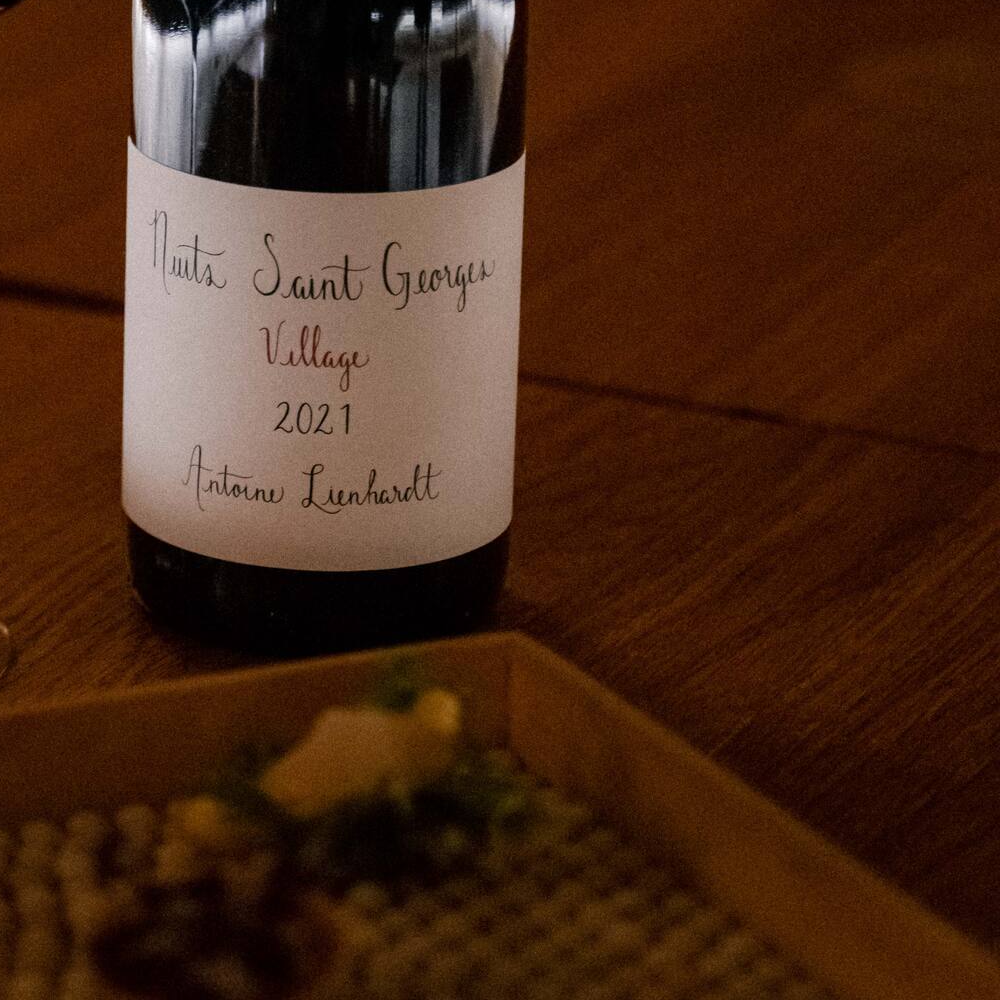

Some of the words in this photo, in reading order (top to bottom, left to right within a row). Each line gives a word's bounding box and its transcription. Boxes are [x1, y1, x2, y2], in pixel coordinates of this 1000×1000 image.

[148, 209, 227, 295] Nuits
[252, 232, 371, 301] Saint
[381, 241, 496, 312] Georges
[259, 320, 370, 392] Village
[273, 401, 351, 435] 2021
[182, 444, 285, 511] Antoine
[300, 462, 443, 515] Lienhardt
